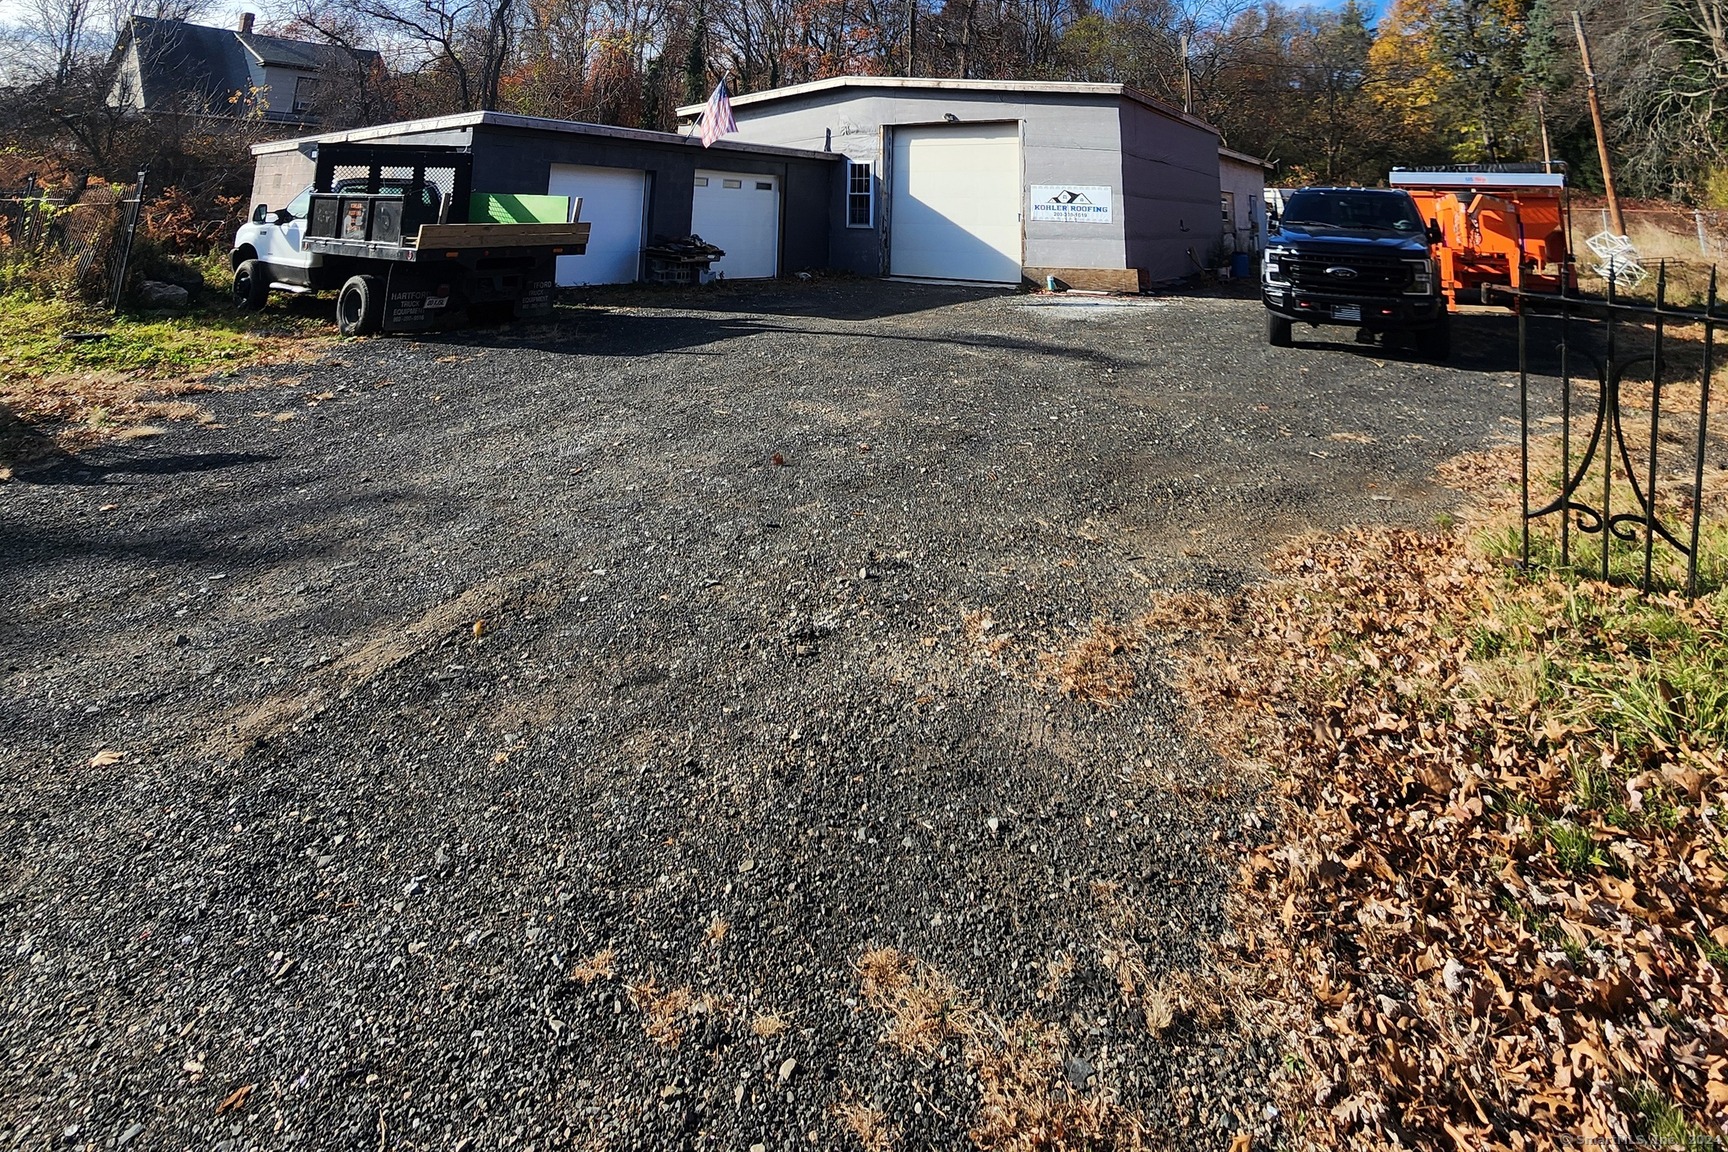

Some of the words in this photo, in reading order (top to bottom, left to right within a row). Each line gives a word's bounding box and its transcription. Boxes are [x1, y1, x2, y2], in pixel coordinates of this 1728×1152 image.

[1070, 205, 1108, 213] ROOFING
[401, 300, 421, 308] TRUCK
[393, 308, 425, 316] EQUIPMENT
